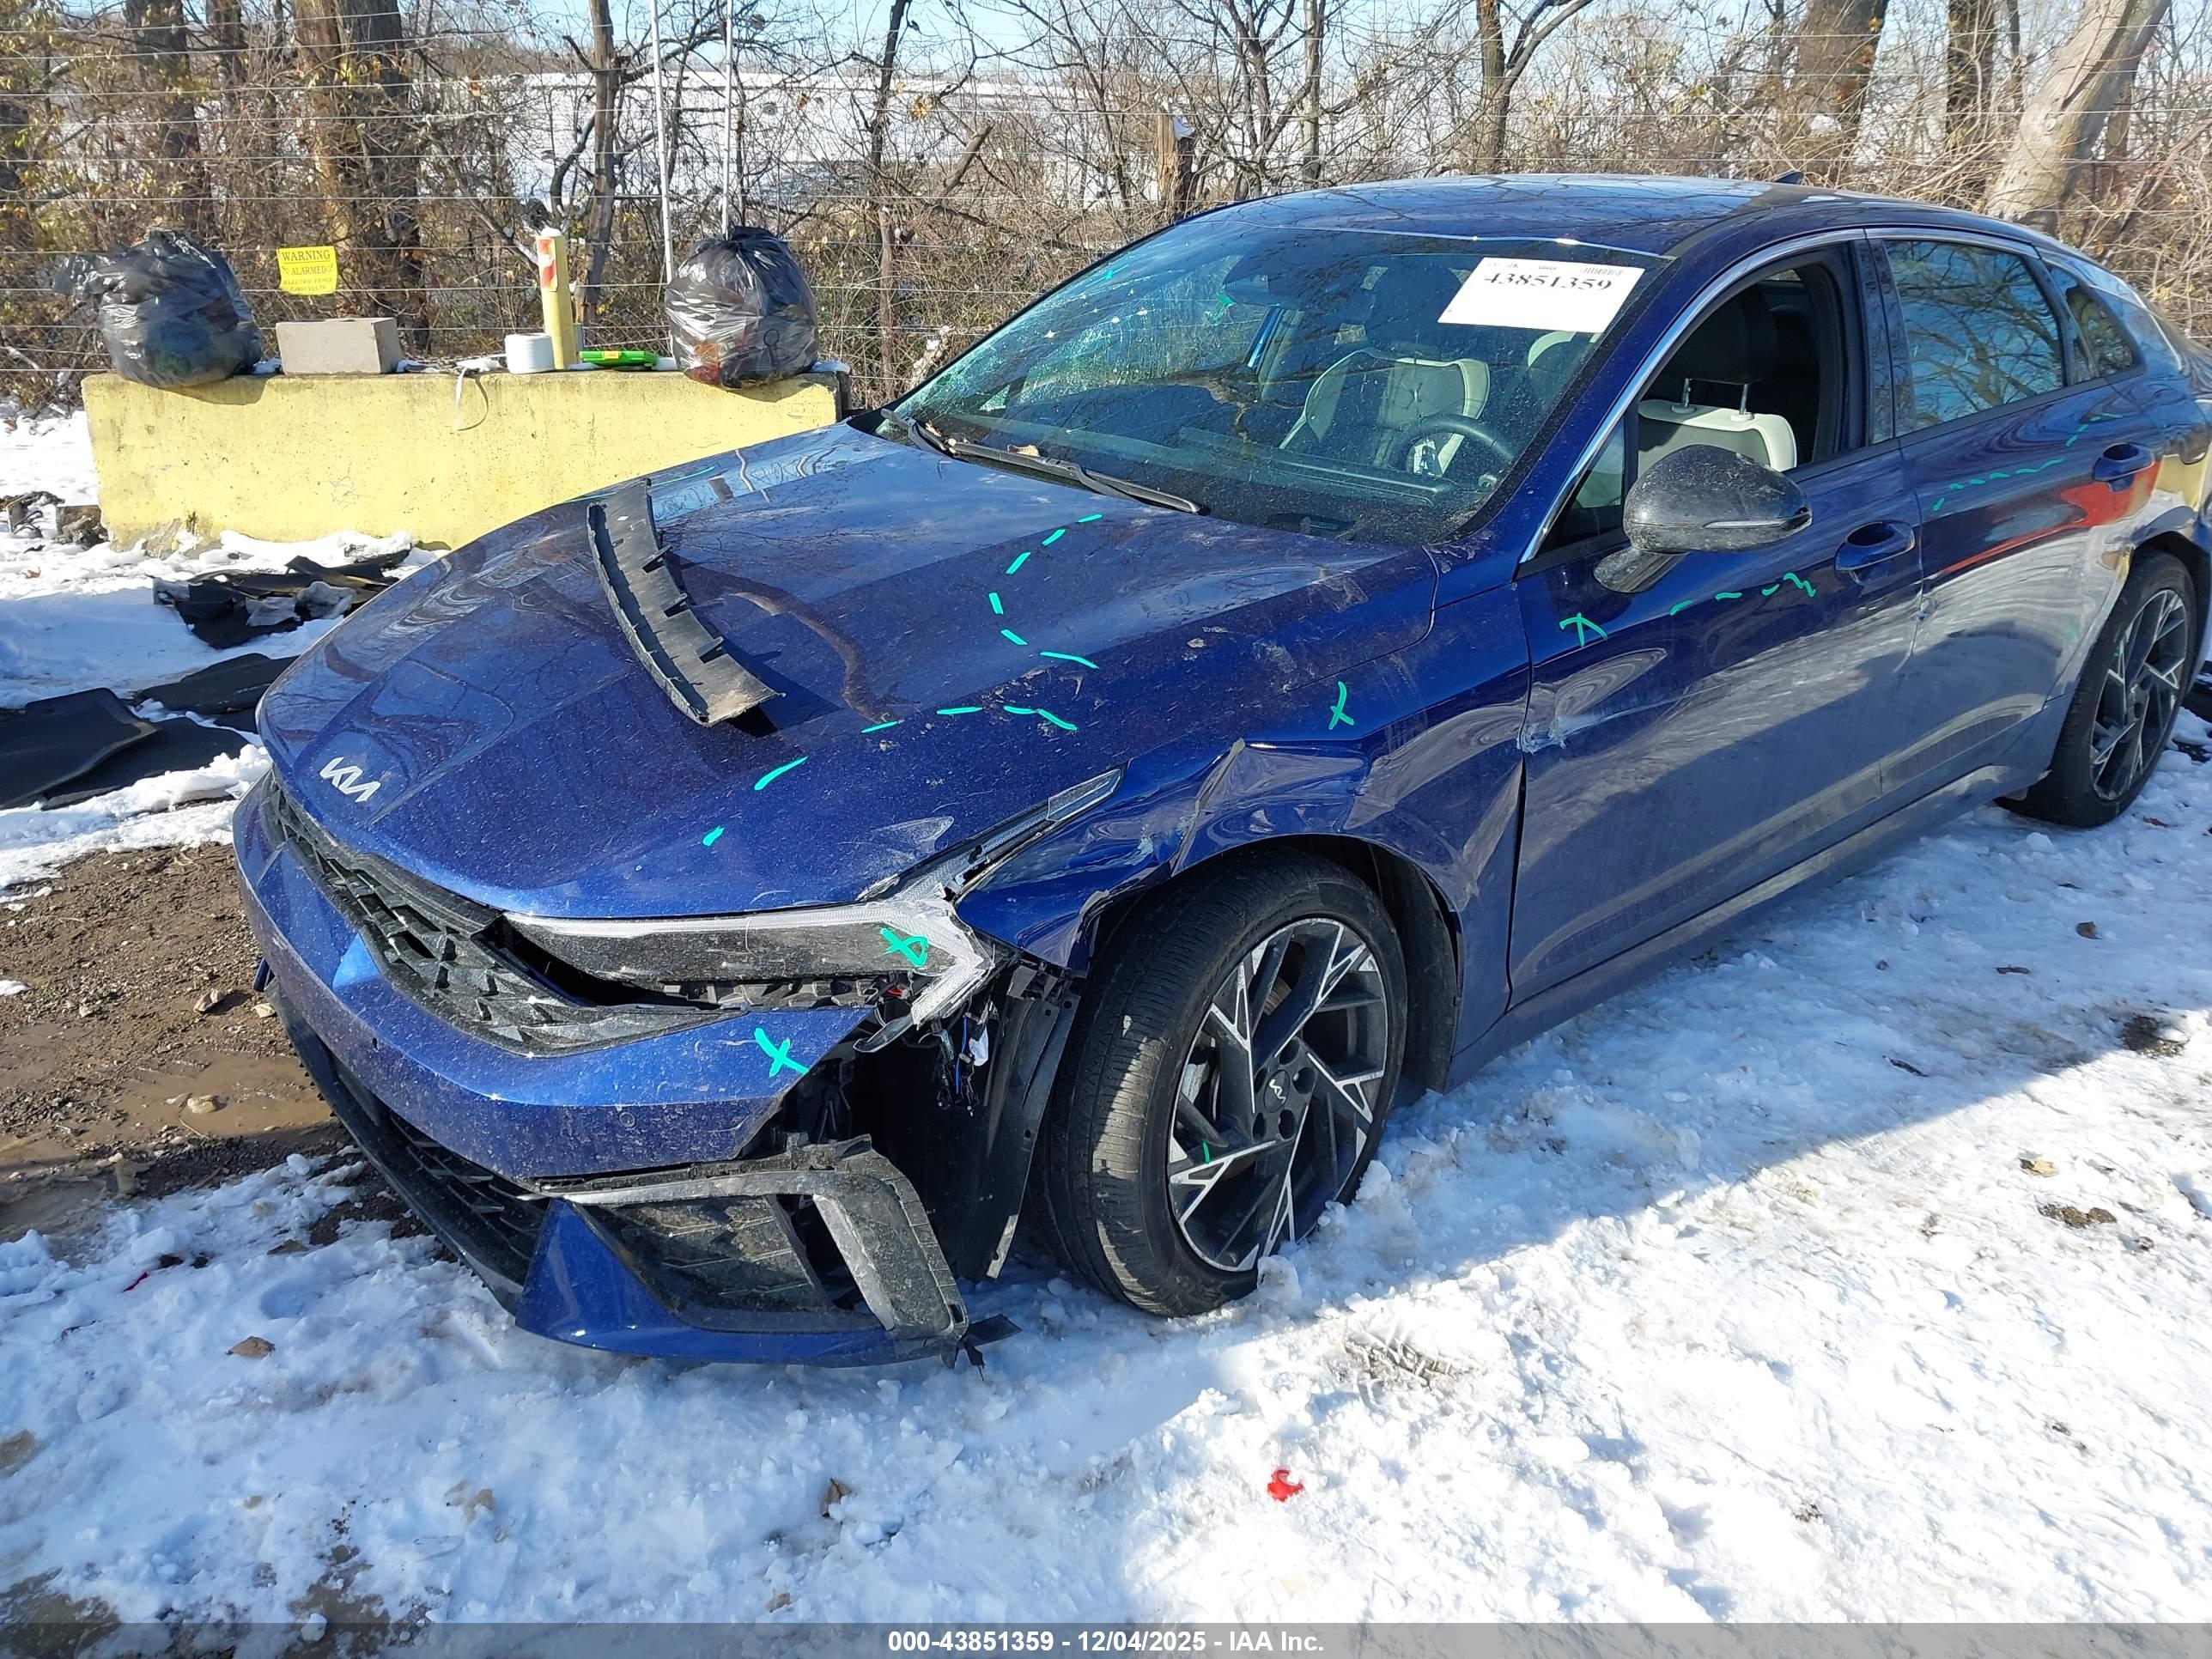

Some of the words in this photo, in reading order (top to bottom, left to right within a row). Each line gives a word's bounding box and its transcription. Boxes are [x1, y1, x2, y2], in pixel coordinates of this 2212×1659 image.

[282, 249, 331, 261] WARNING
[291, 265, 327, 276] ALARMED
[1484, 272, 1613, 290] 43851359
[319, 757, 381, 803] KIA
